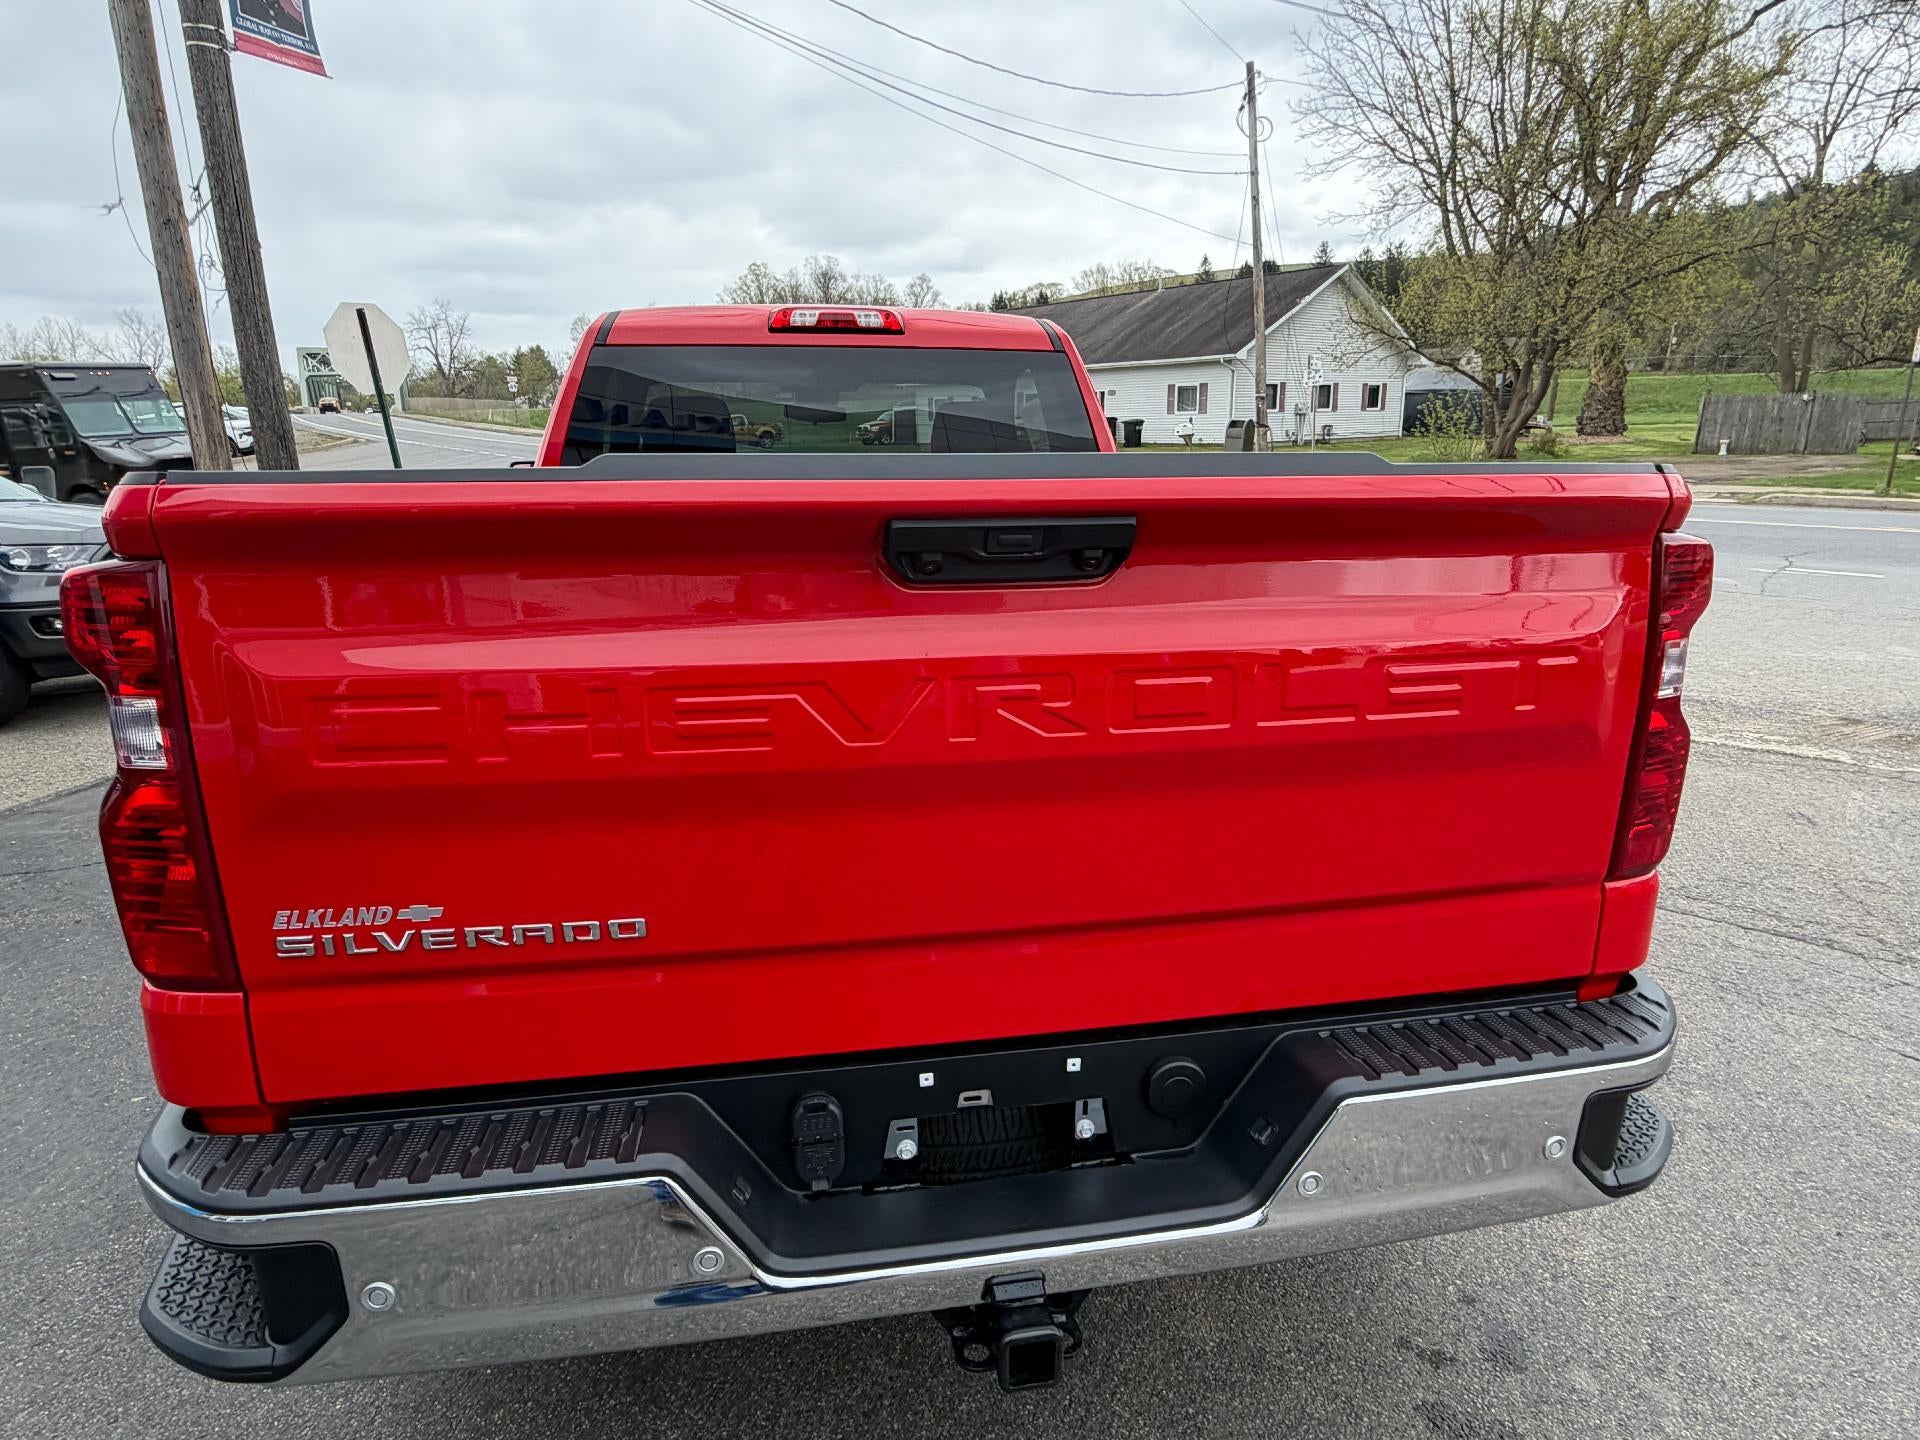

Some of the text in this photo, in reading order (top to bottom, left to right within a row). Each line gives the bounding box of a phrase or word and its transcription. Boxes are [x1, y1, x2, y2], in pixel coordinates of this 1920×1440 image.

[304, 646, 1584, 769] CHEVROLET
[272, 905, 393, 930] ELKLAND
[275, 917, 647, 958] SILVERADO
